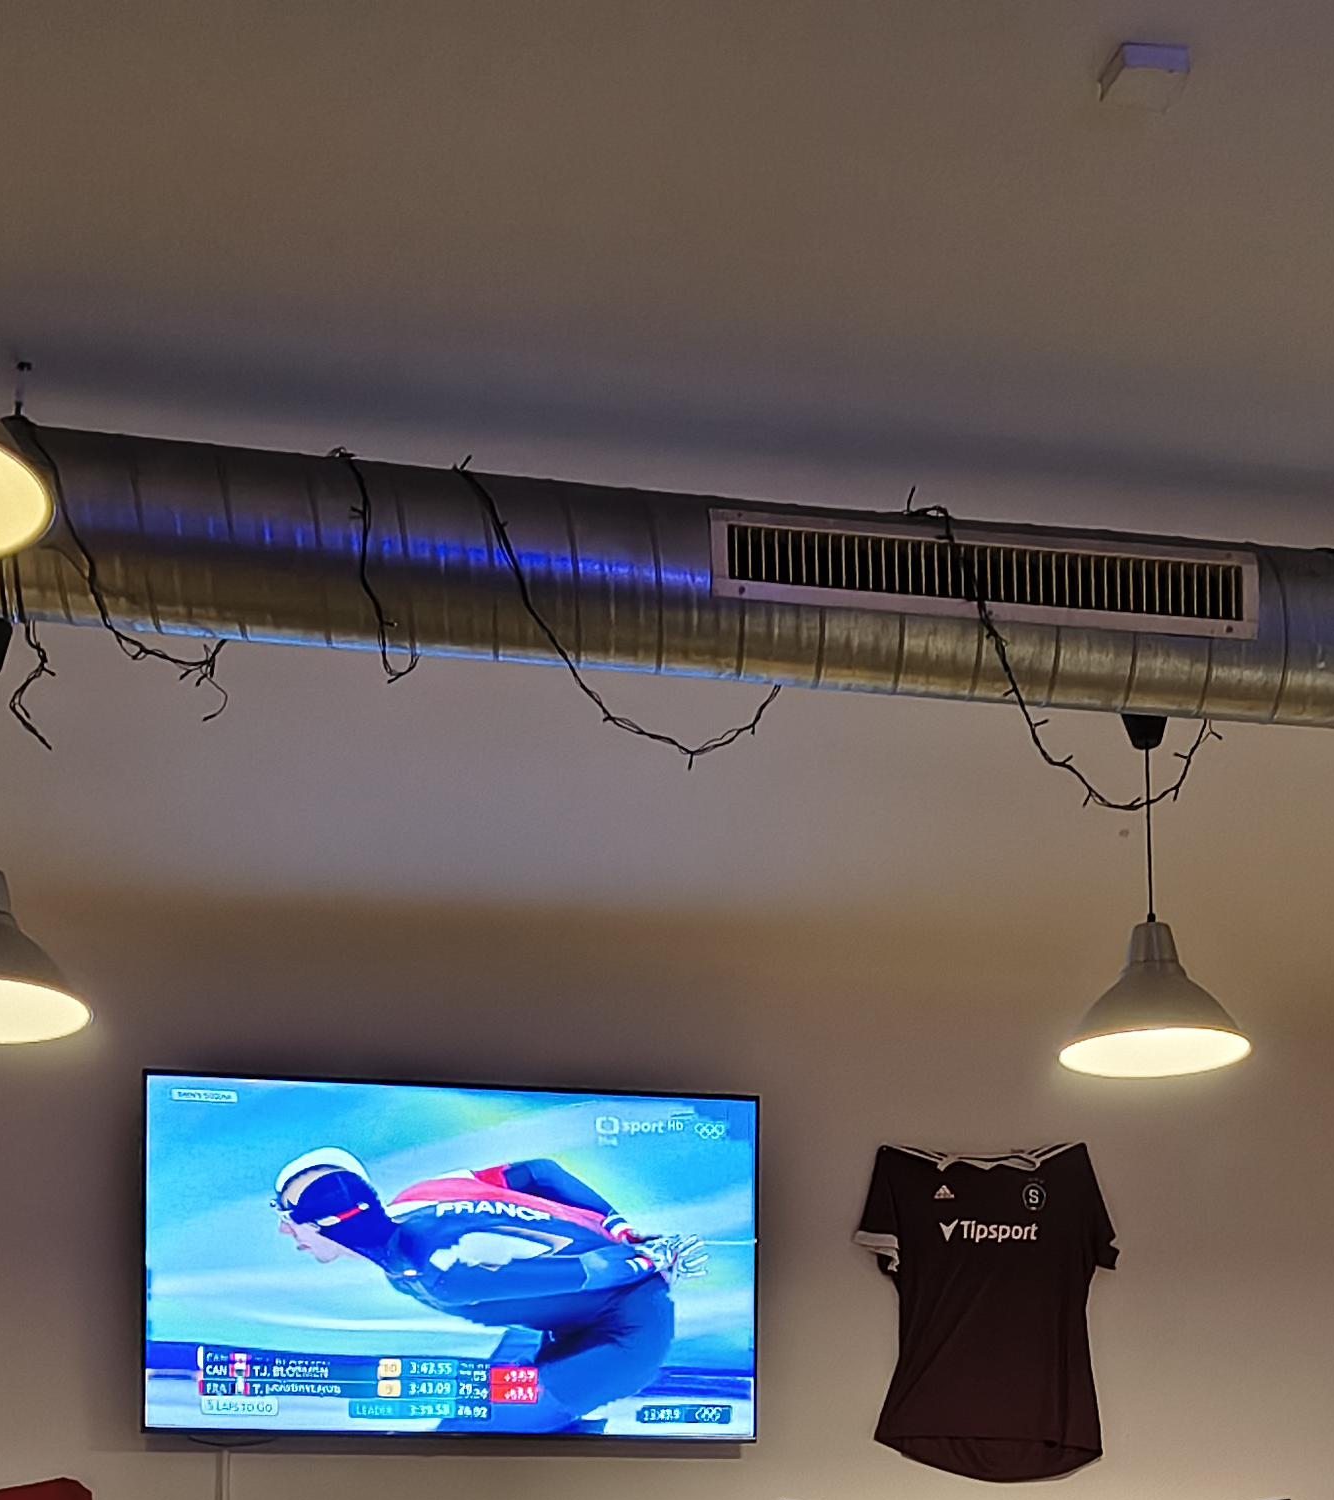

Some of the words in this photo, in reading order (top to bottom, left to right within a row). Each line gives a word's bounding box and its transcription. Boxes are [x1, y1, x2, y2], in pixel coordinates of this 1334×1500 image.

[960, 1220, 1038, 1243] Tipsport
[206, 1365, 227, 1376] CAN
[241, 1402, 254, 1412] TO
[257, 1402, 273, 1413] GO
